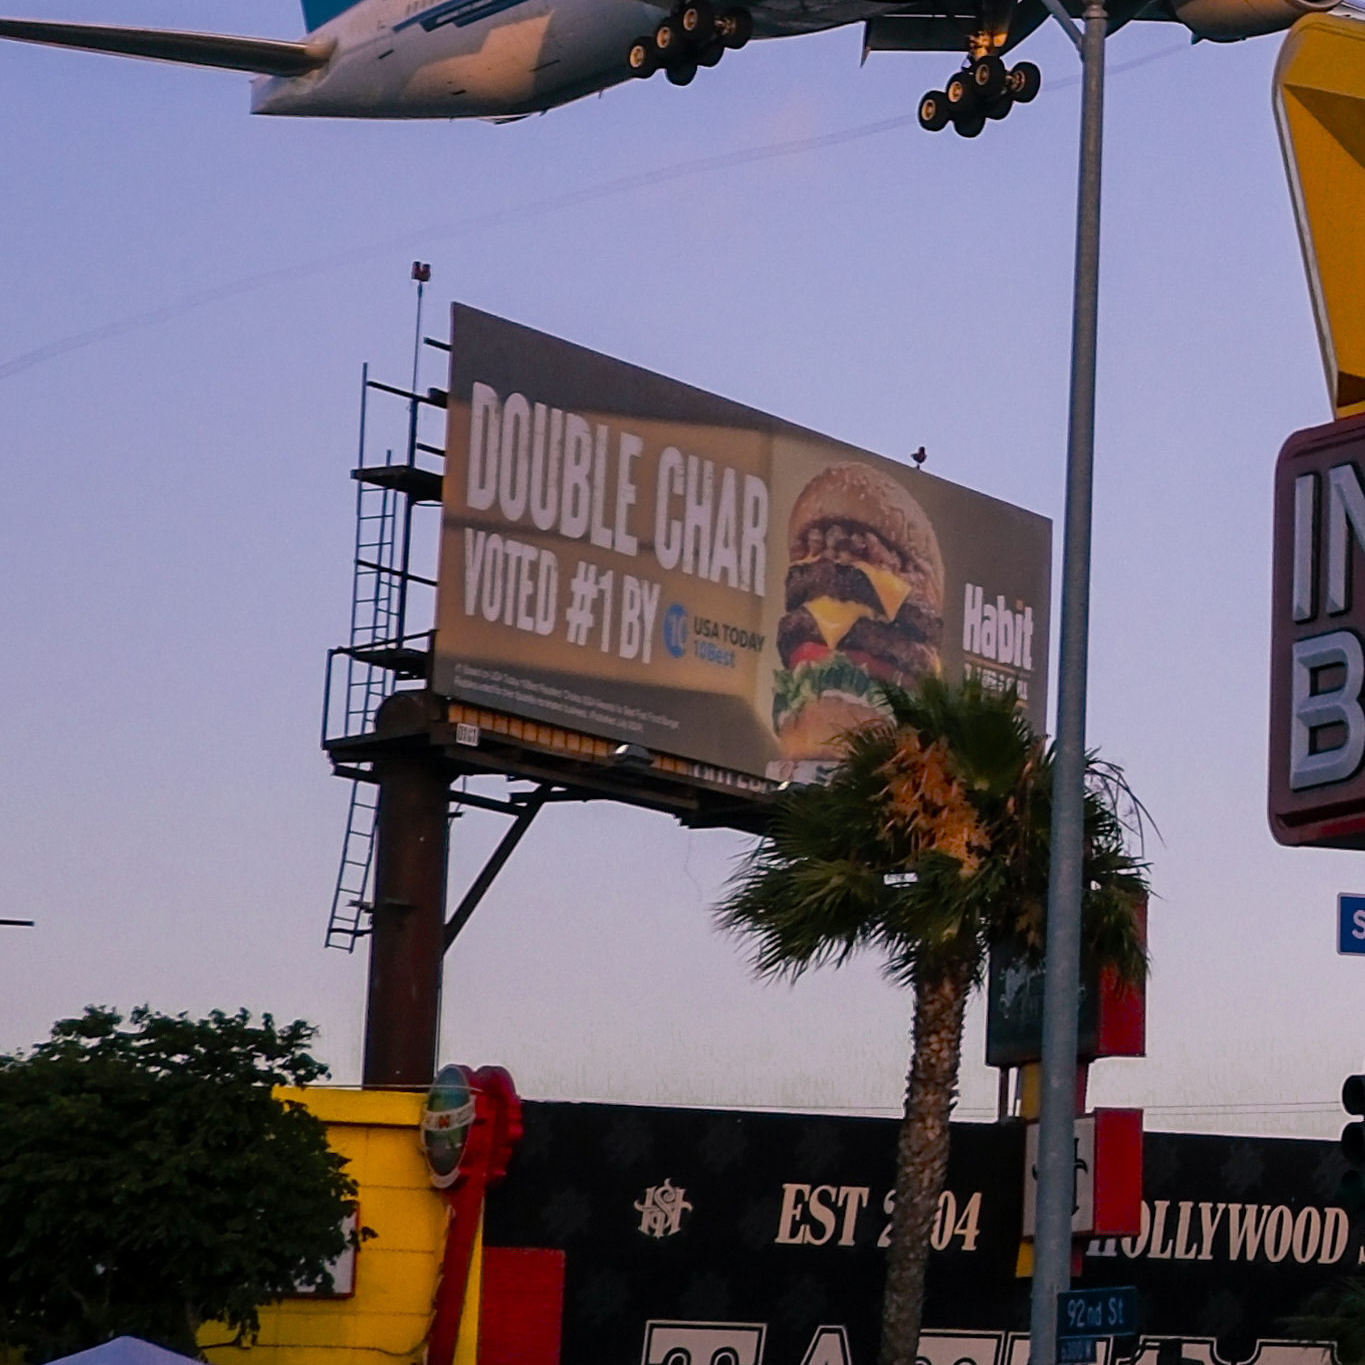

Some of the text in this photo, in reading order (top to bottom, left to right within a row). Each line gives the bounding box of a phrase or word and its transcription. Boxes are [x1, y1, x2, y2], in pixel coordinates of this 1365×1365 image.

[467, 381, 768, 597] DOUBLE CHAR
[465, 527, 661, 664] VOTED #1 BY
[963, 582, 1033, 670] Habit
[693, 616, 765, 652] USA TODAY
[774, 1183, 869, 1247] EST
[1067, 1296, 1124, 1327] 92nd St
